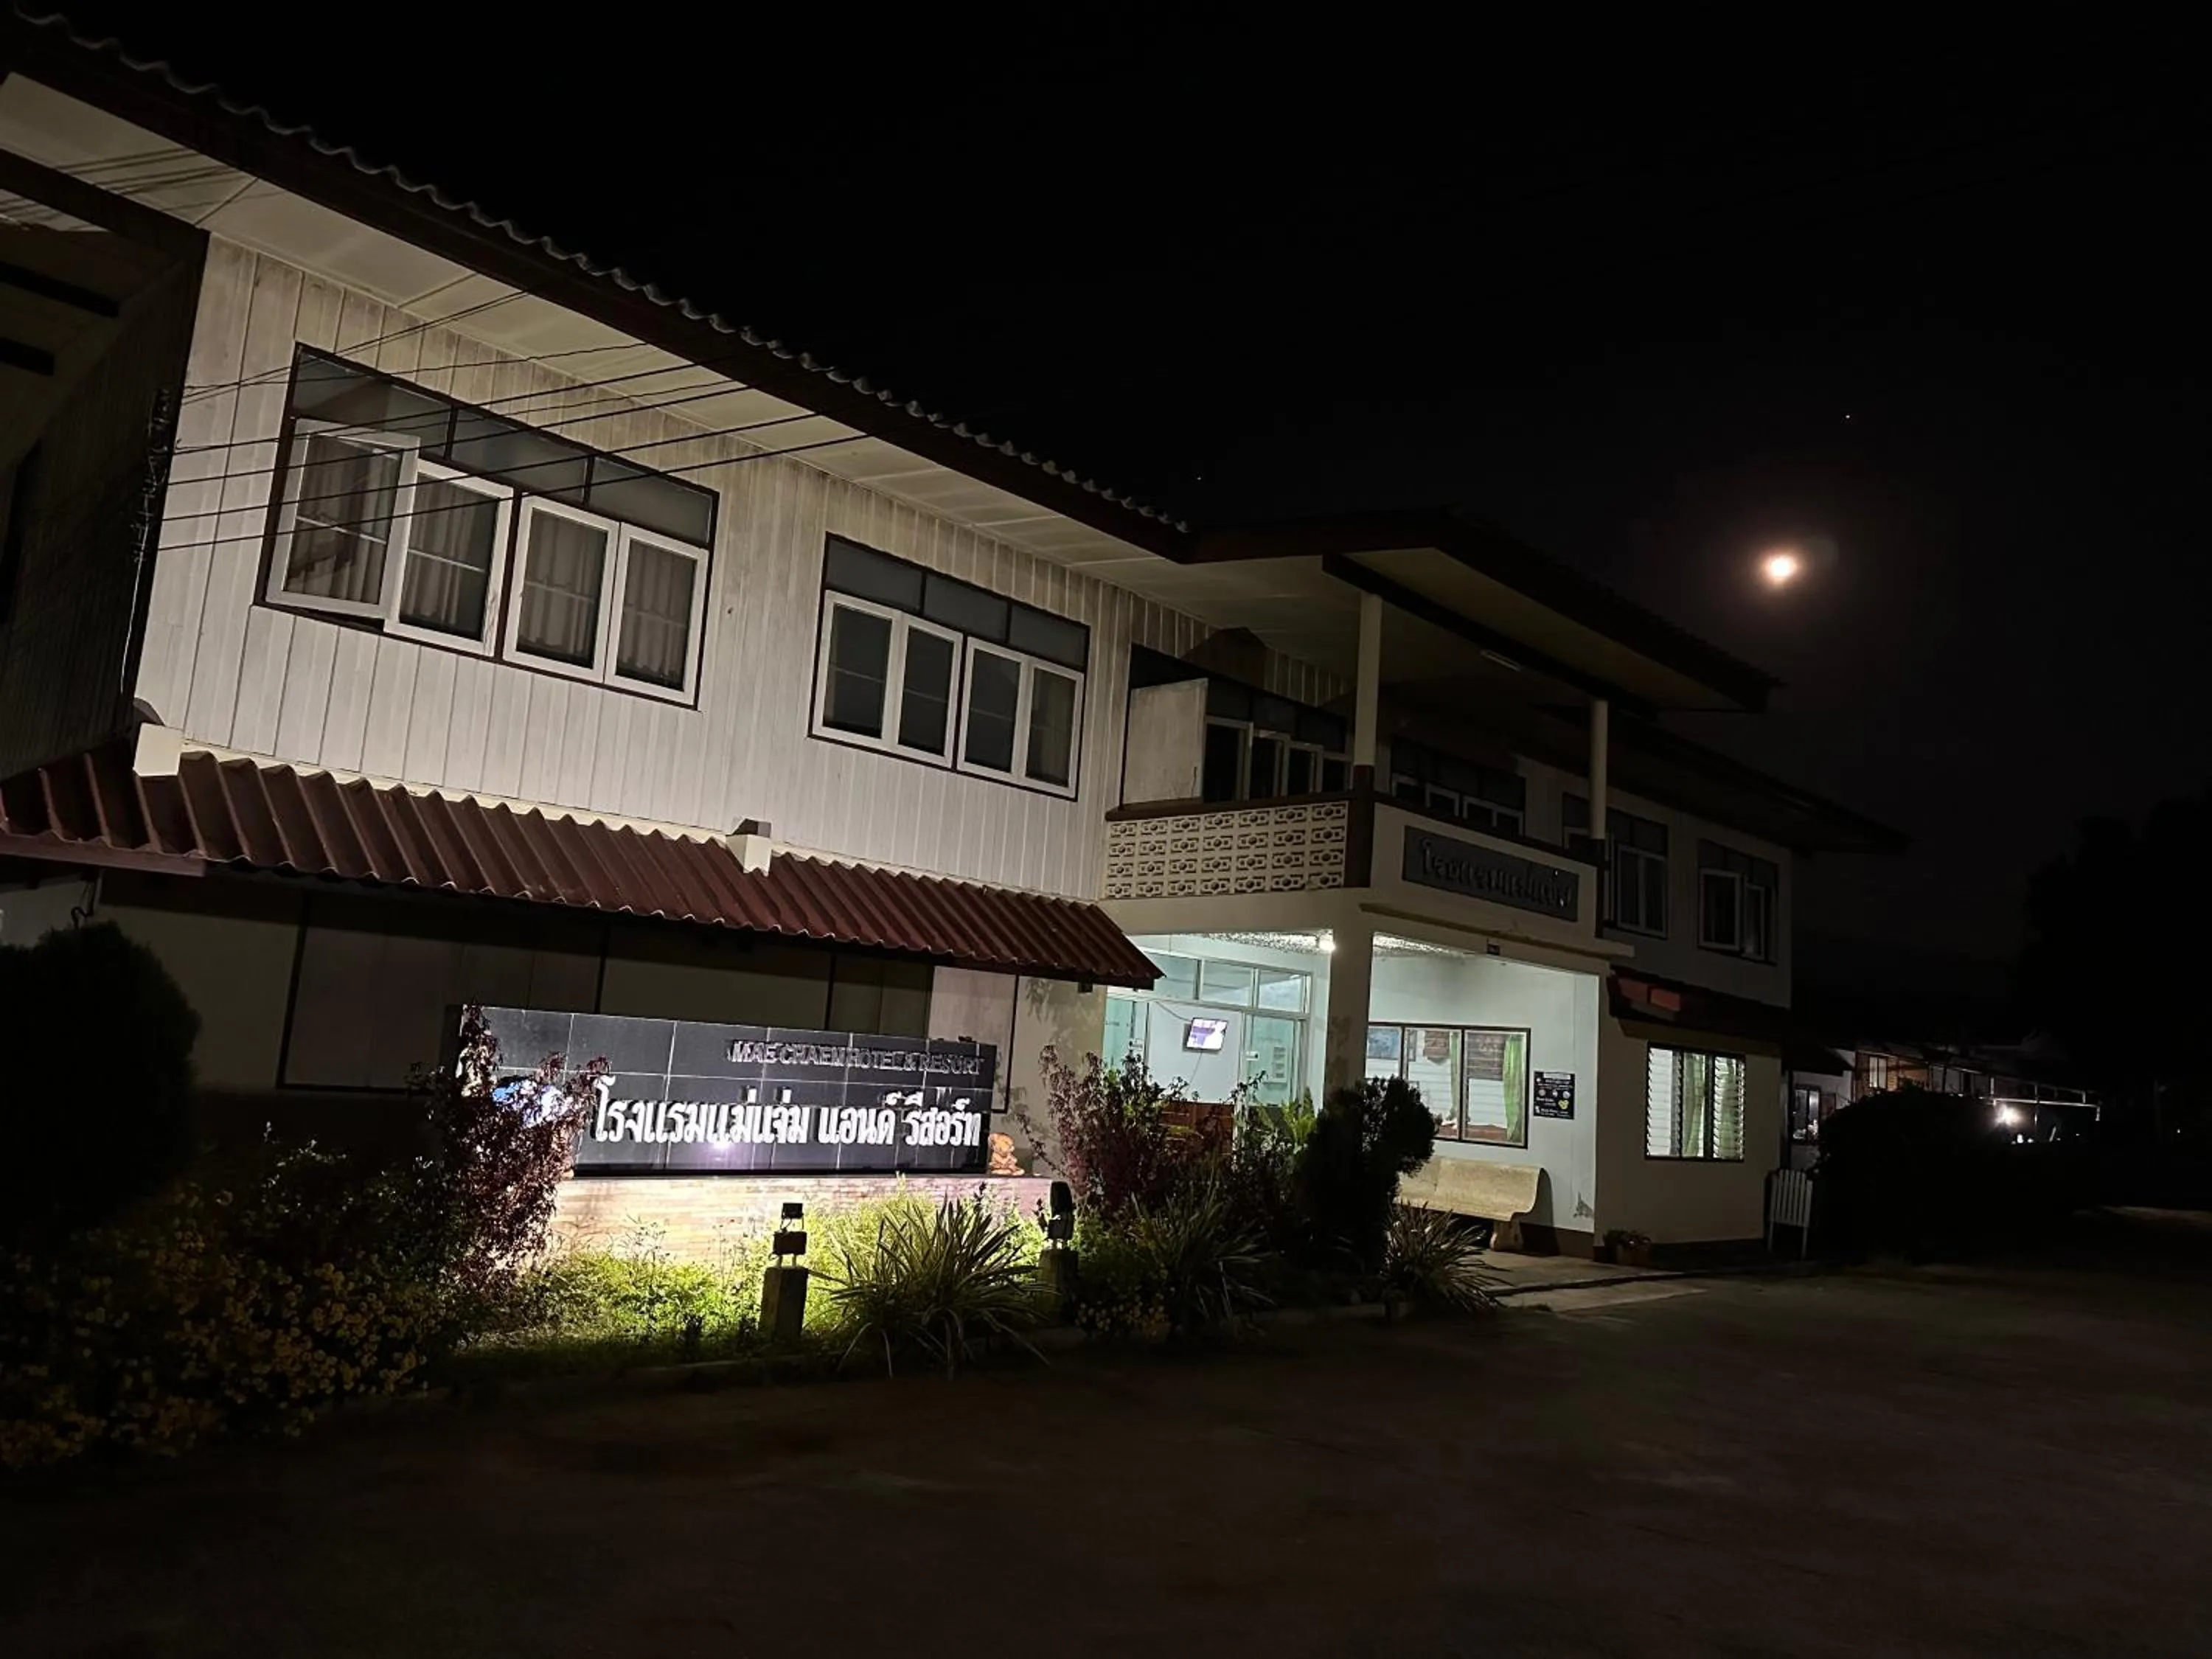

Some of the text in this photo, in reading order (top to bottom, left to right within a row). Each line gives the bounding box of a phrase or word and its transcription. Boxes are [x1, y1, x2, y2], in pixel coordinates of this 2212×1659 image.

[731, 1040, 776, 1063] MAE
[847, 1047, 904, 1071] HOTEL
[595, 1074, 981, 1147] โรงแรมแม่แจ่ม แอนด์ รีสอร์ท
